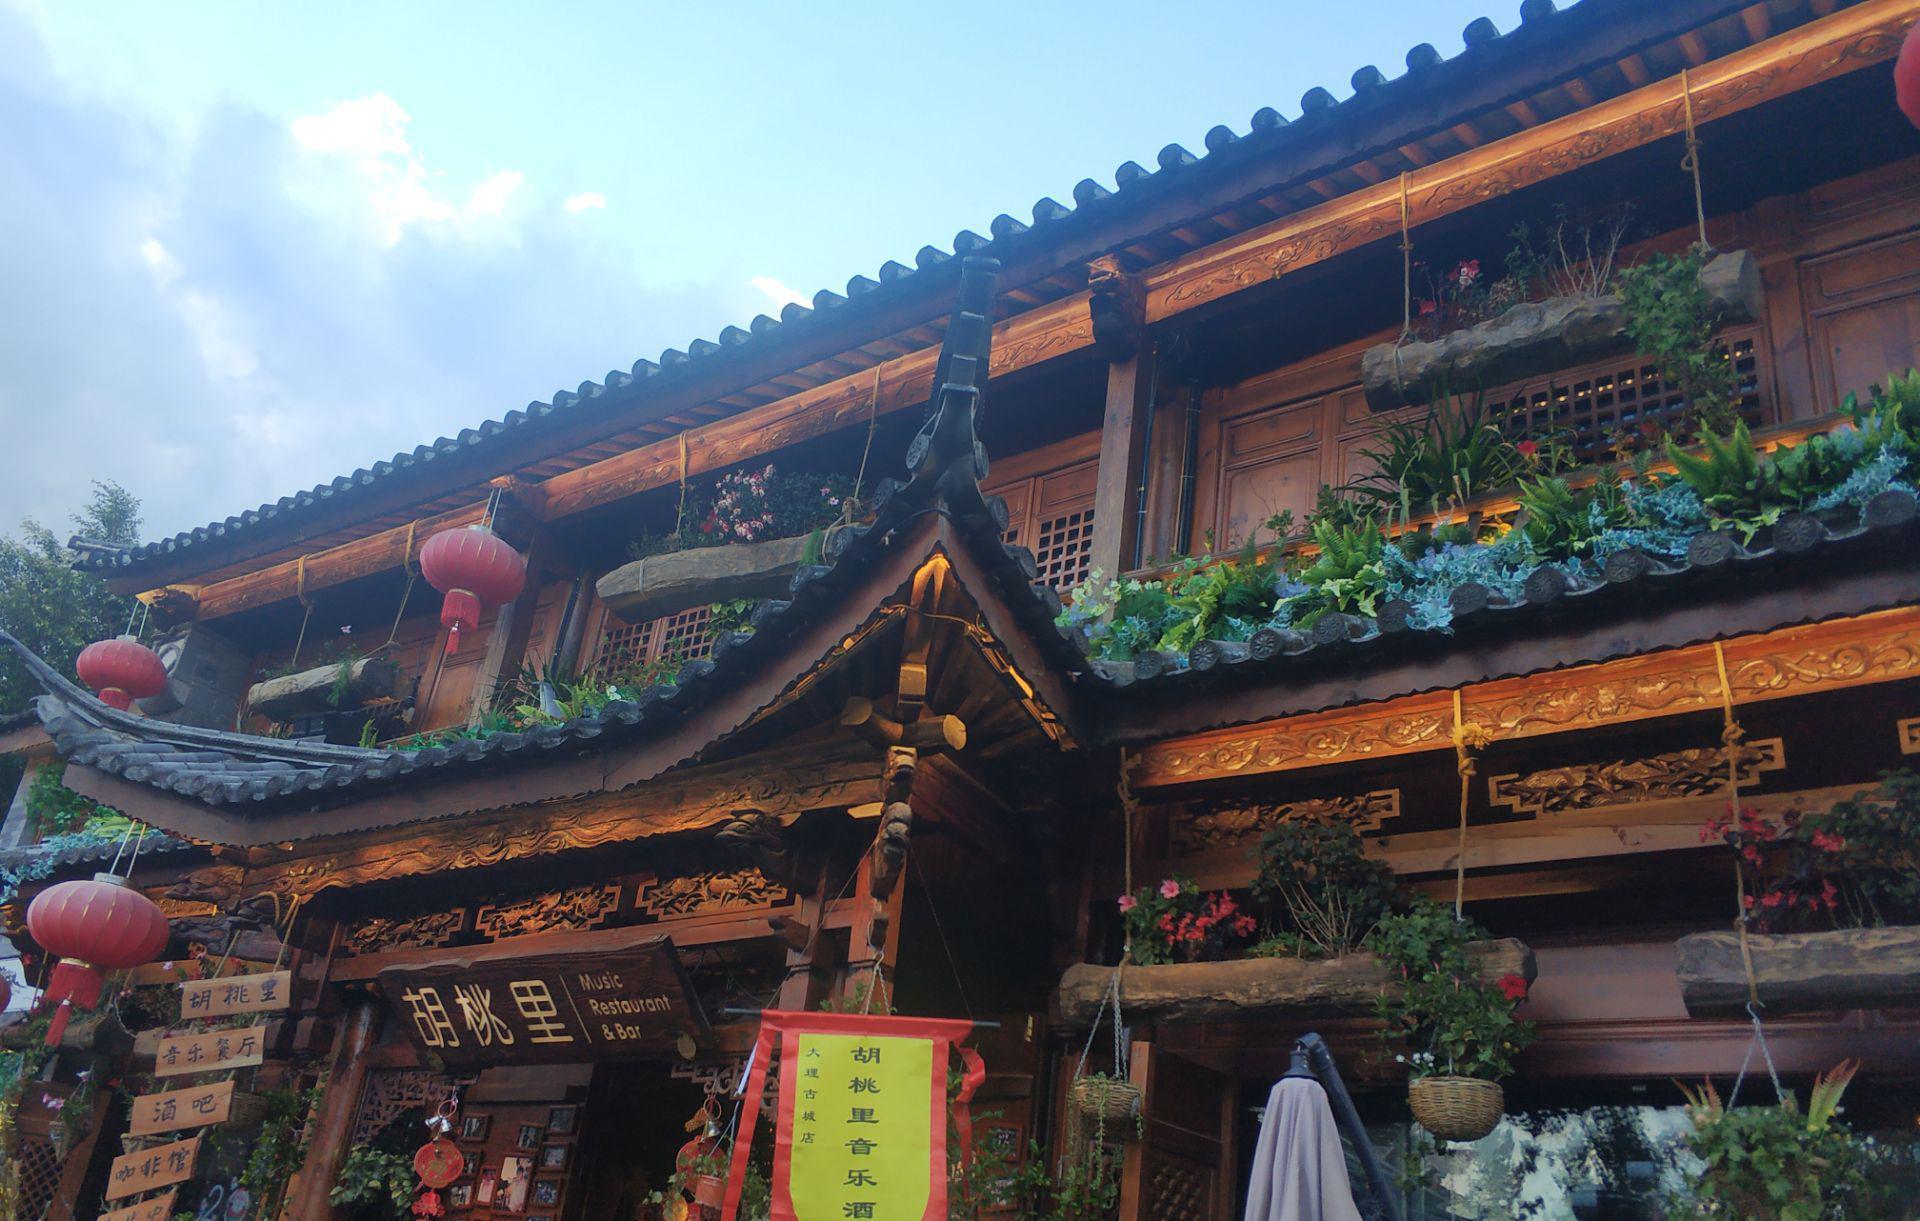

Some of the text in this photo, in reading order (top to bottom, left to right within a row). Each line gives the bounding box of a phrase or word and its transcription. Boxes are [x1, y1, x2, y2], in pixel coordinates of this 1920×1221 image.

[579, 972, 623, 990] Music
[188, 980, 277, 1011] 胡桃里
[590, 995, 672, 1016] Restaurant
[402, 980, 574, 1049] 胡桃里
[602, 1024, 642, 1041] & Bar
[162, 1037, 256, 1065] 音乐餐厅
[153, 1095, 216, 1122] 酒吧
[800, 1047, 821, 1144] 大理古城店
[842, 1046, 881, 1219] 胡桃里音乐酒
